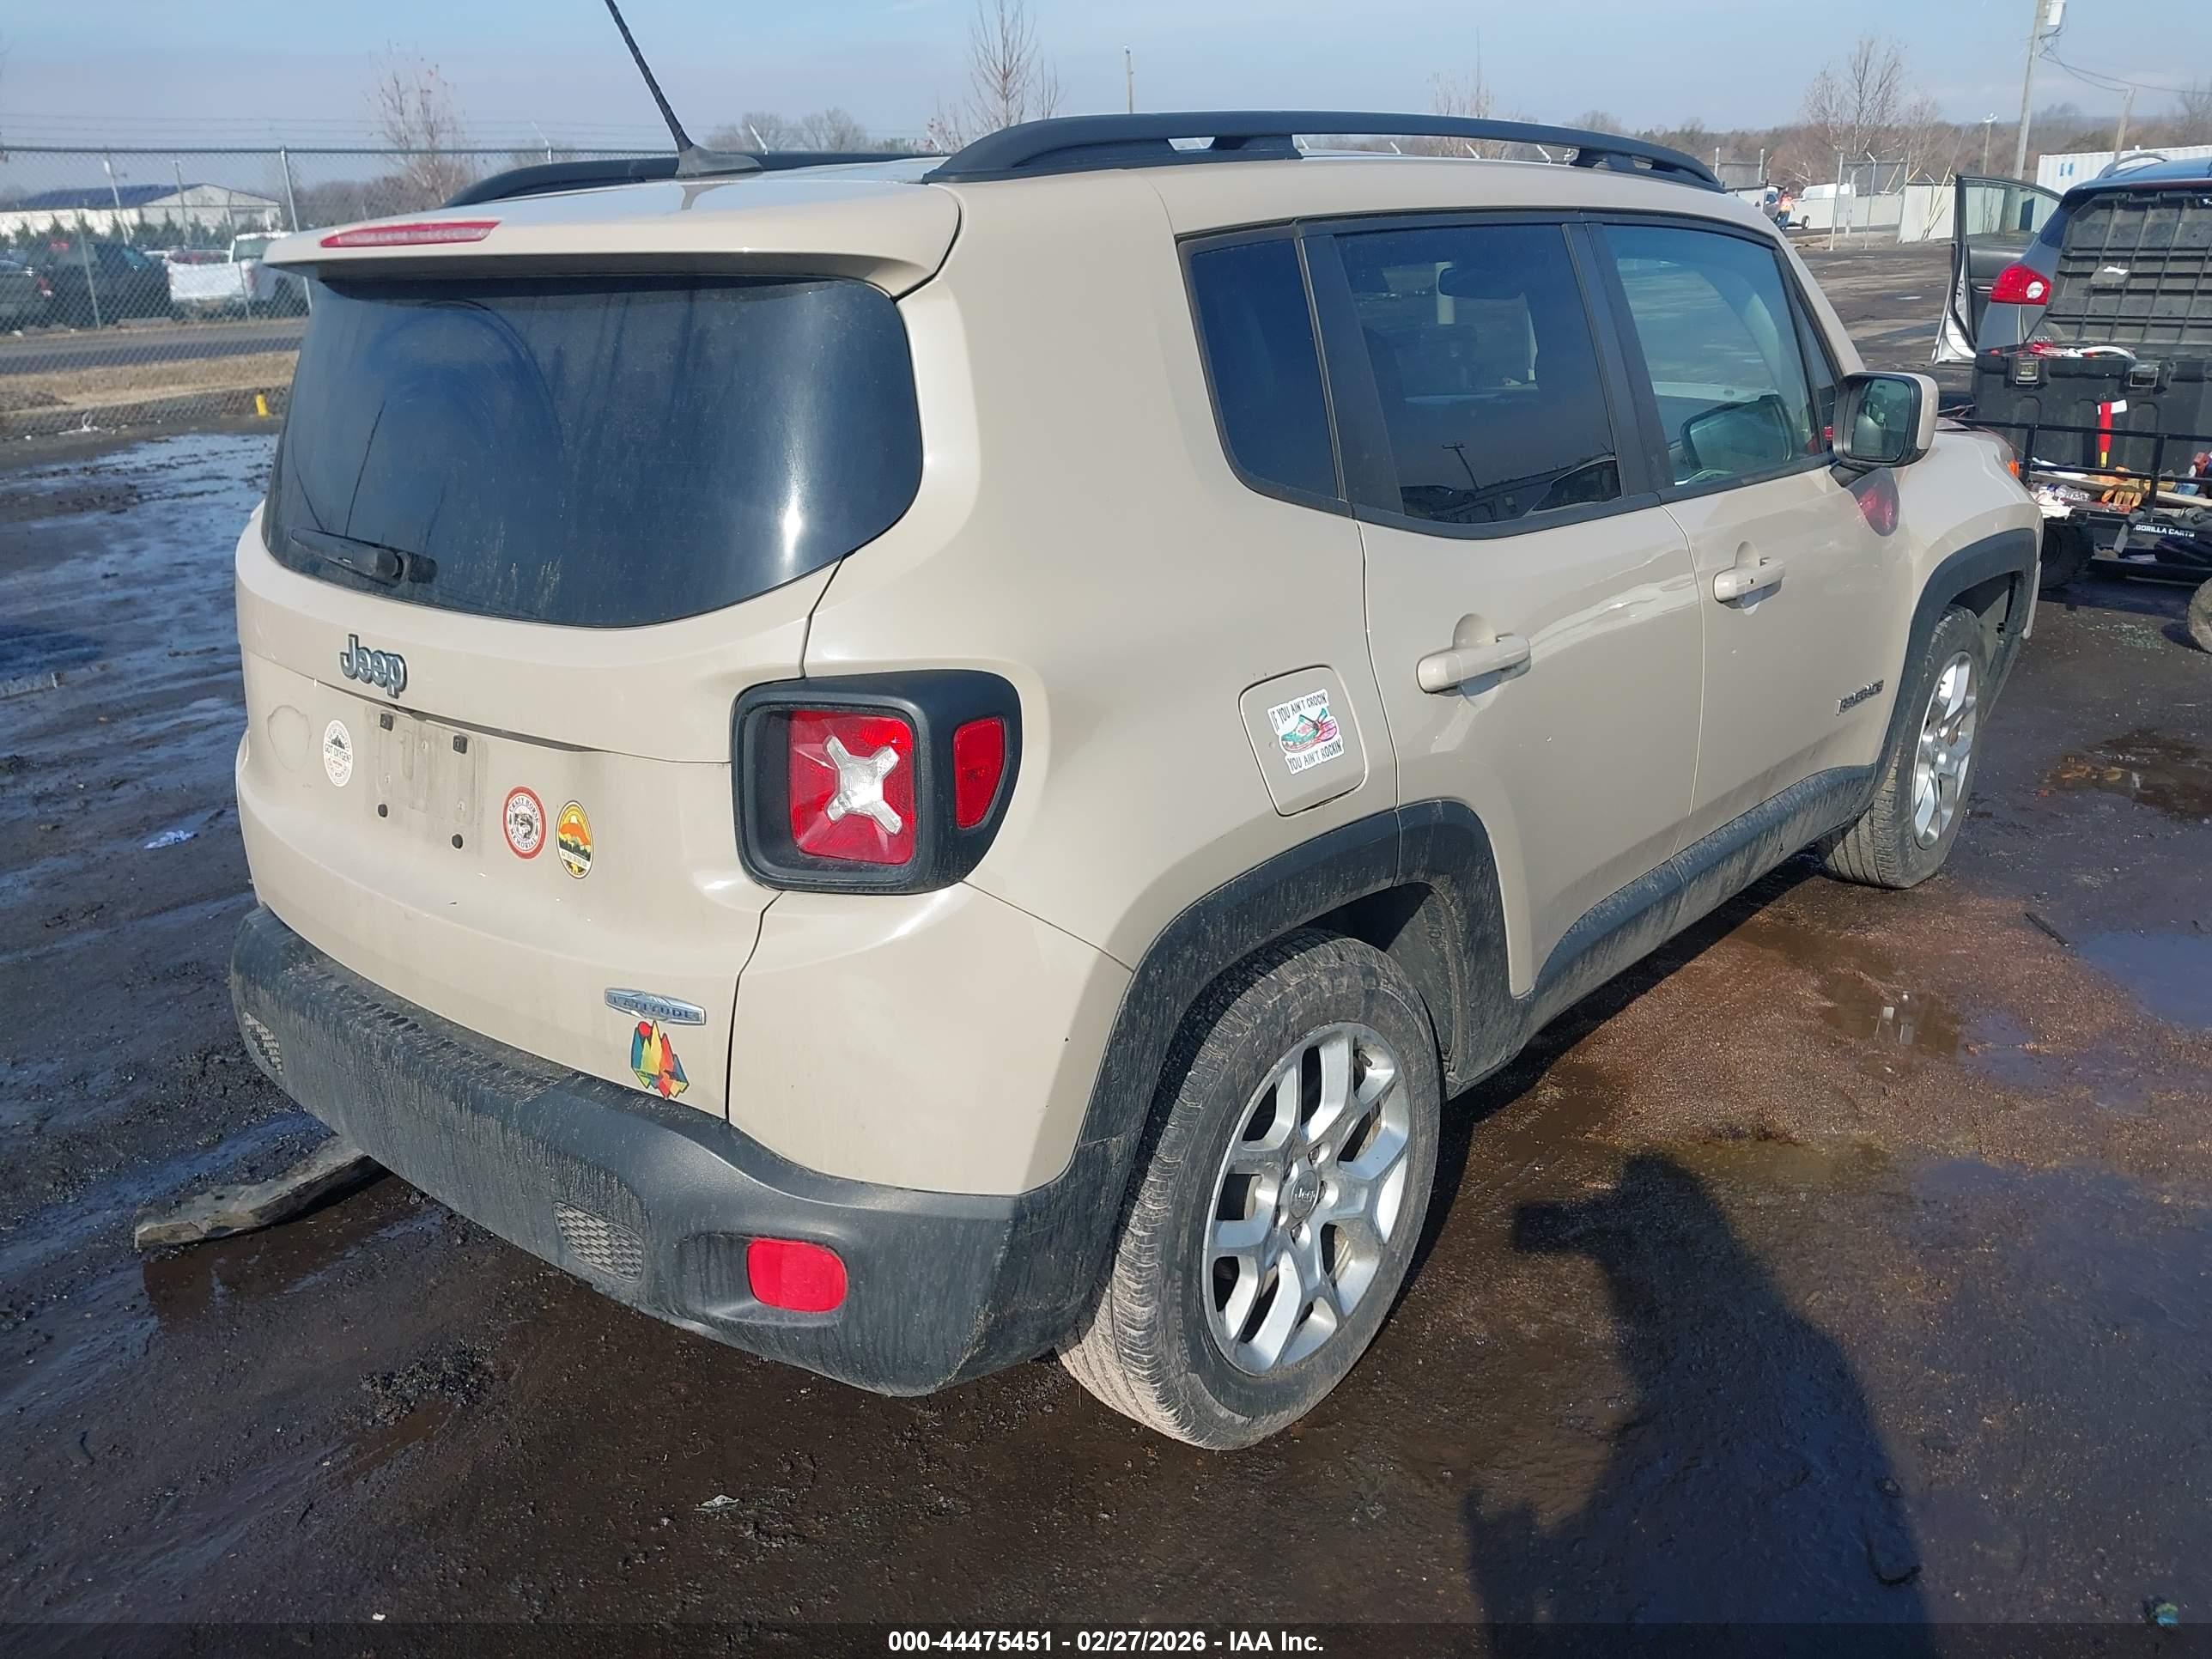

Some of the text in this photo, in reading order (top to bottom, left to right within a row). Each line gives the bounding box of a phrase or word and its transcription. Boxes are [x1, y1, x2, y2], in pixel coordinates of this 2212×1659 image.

[2136, 525, 2196, 538] GORILLA CARTS
[340, 633, 408, 699] Jeep
[1276, 707, 1291, 725] YOU
[1291, 700, 1306, 716] AIN'T
[1287, 755, 1303, 771] YOU
[1304, 750, 1321, 766] AIN'T
[508, 797, 525, 812] CRAZY
[509, 827, 538, 849] MEMORIAL
[612, 996, 693, 1019] LATITUDE
